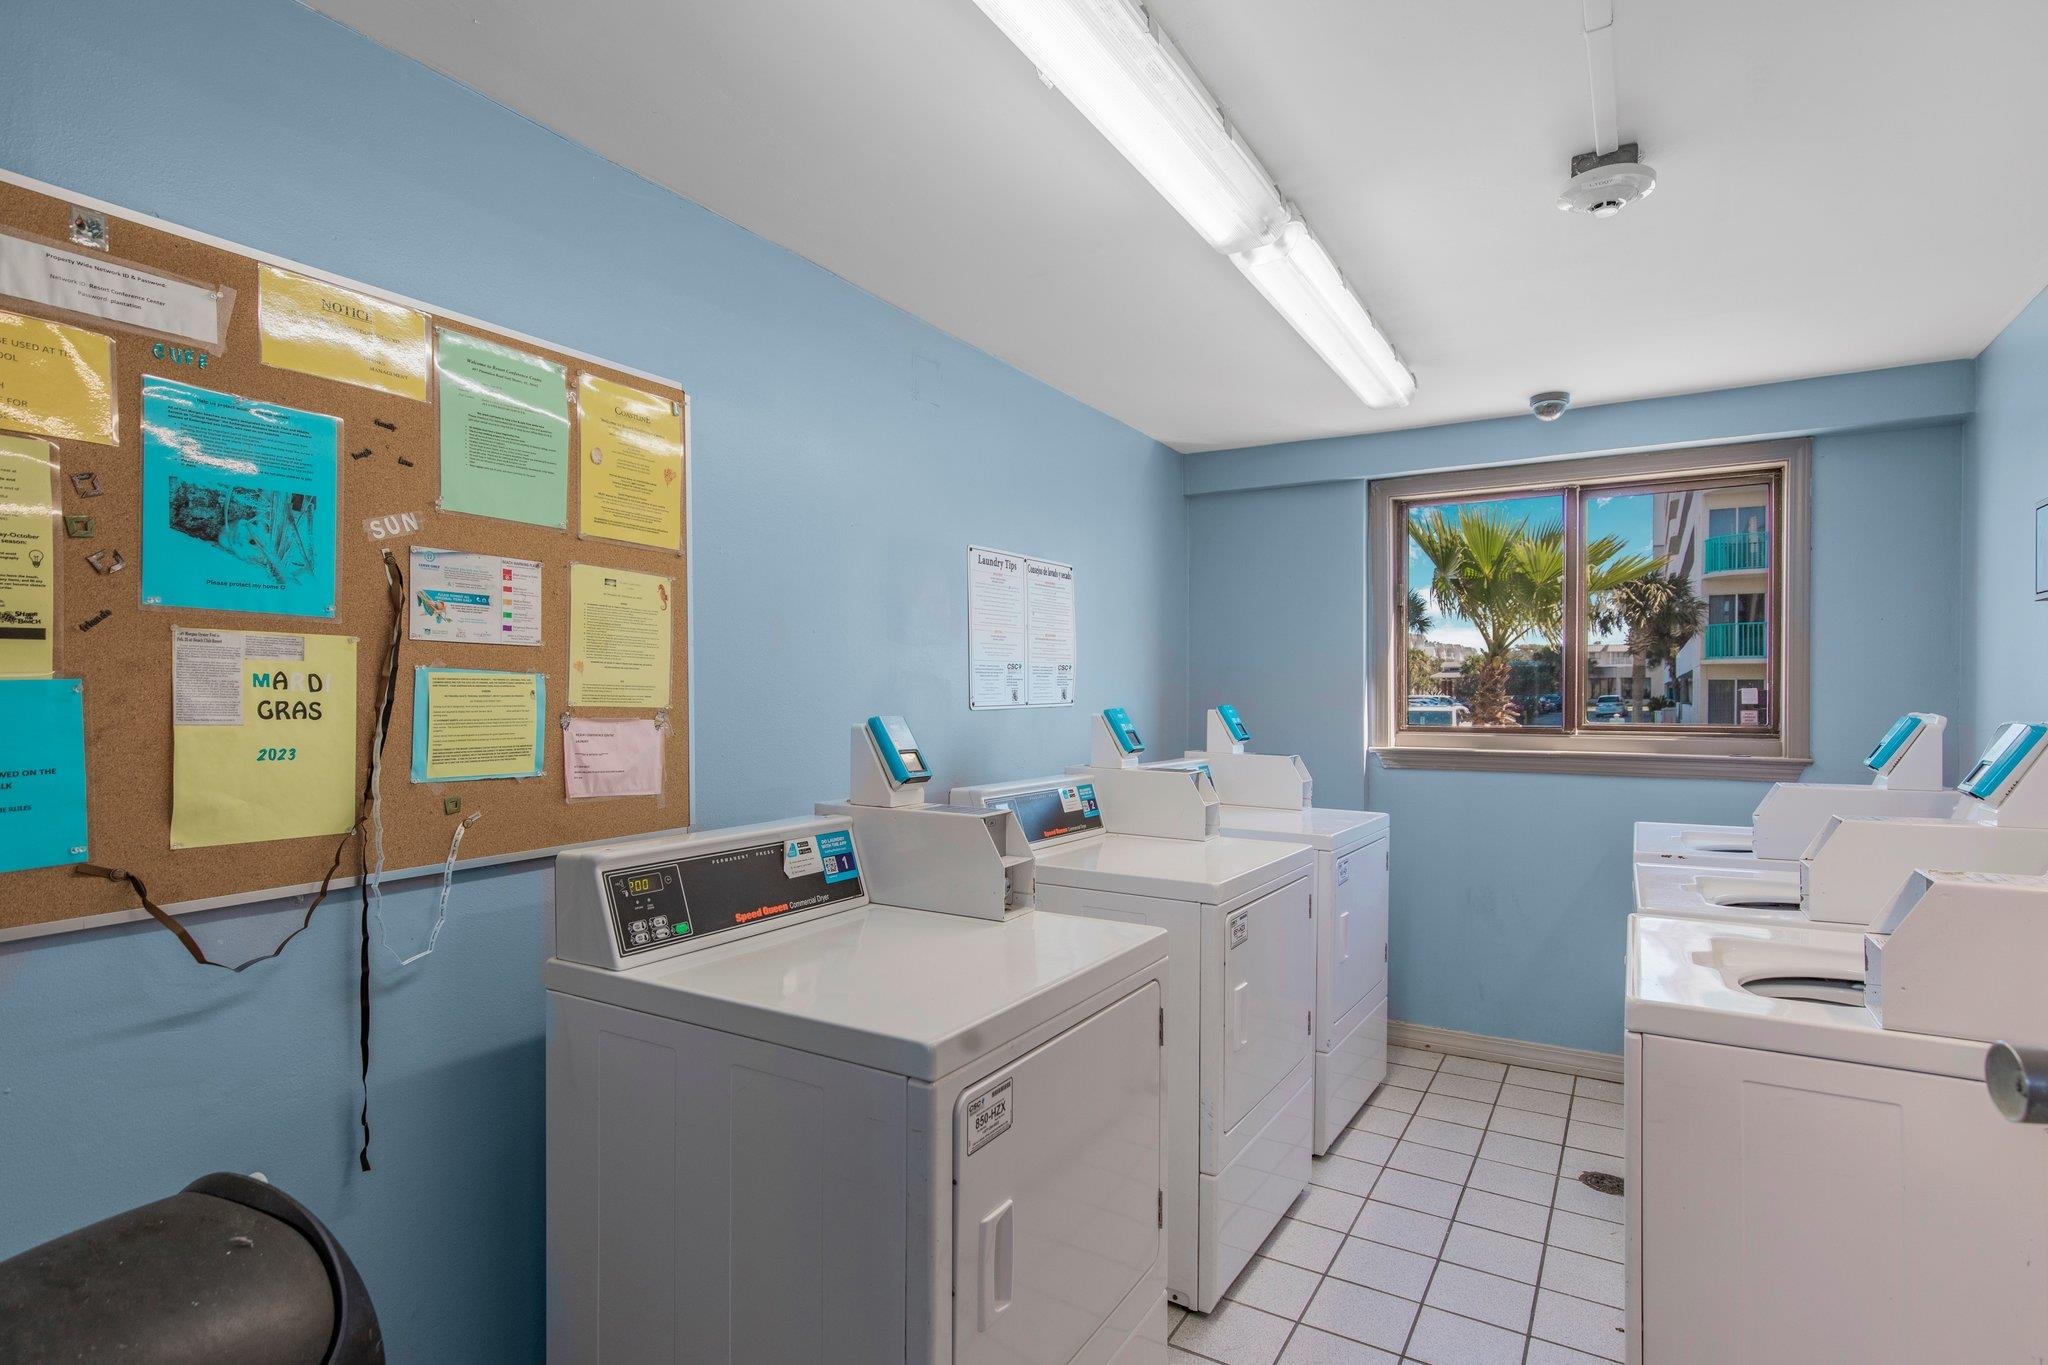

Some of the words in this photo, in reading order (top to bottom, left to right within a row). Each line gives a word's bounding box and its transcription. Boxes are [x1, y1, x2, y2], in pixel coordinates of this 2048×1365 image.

[45, 252, 75, 265] Property
[76, 260, 93, 269] Wide
[94, 265, 121, 276] Network
[49, 273, 78, 285] Network
[89, 283, 110, 293] Resort
[110, 288, 146, 302] Conference
[146, 297, 166, 307] Center
[110, 299, 142, 310] plantation
[321, 299, 372, 321] NOTICE
[11, 338, 40, 352] USED
[42, 346, 55, 355] AT
[6, 397, 28, 408] FOR
[370, 512, 419, 539] SUN
[977, 554, 1004, 570] Laundry
[1005, 559, 1017, 572] Tips
[206, 579, 228, 587] Please
[229, 580, 251, 588] protect
[252, 582, 261, 590] my
[1007, 662, 1019, 670] CSC
[257, 700, 323, 721] GRAS
[256, 747, 297, 762] 2023
[40, 768, 56, 776] THE
[1090, 800, 1096, 809] 2
[1044, 829, 1056, 838] Speed
[711, 854, 749, 864] PERMANENT
[755, 849, 775, 857] PRESS
[842, 855, 848, 869] 1
[735, 908, 762, 923] Speed
[762, 902, 788, 916] Queen
[789, 896, 816, 909] Commercial
[816, 894, 830, 903] Dryer
[975, 1101, 1006, 1129] 850-HZX
